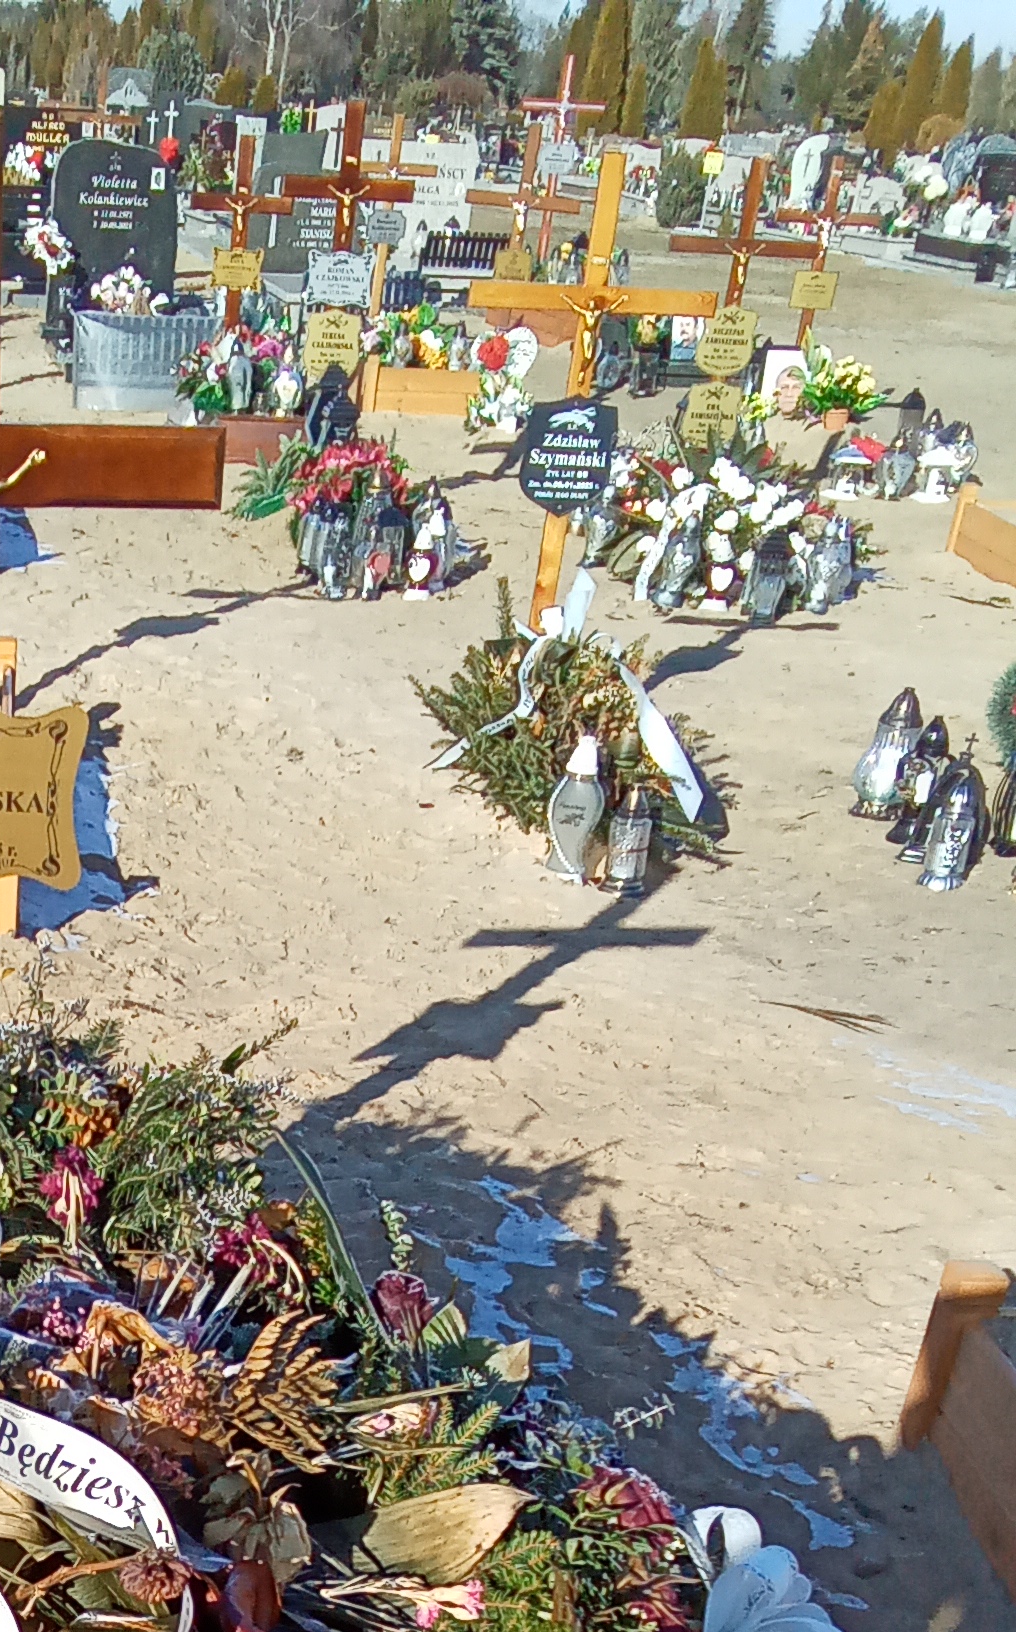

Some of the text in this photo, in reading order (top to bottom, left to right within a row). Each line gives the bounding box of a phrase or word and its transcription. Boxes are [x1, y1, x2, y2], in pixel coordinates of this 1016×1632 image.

[91, 174, 138, 190] Violetta
[78, 190, 149, 208] Kolankiewicz
[542, 432, 602, 449] Zdzisław
[528, 448, 608, 469] Szymański
